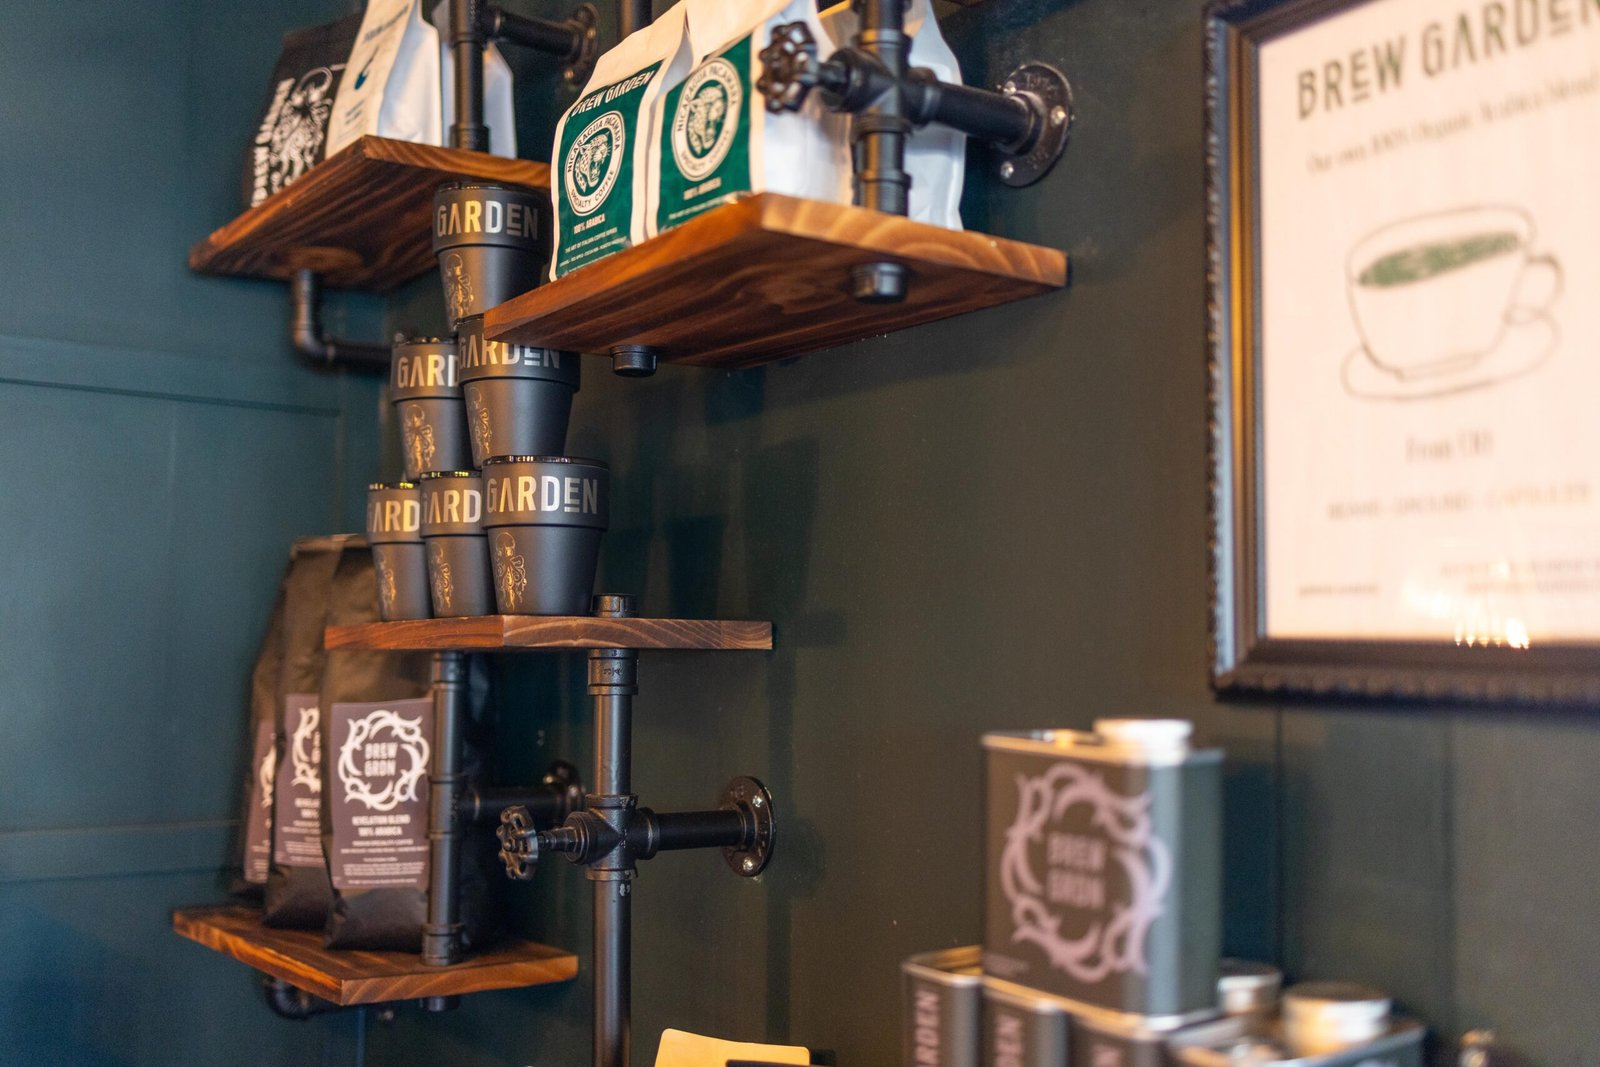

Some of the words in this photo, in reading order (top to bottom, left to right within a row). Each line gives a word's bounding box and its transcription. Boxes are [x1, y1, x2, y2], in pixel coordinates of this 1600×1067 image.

[605, 70, 655, 104] GARDEN
[1298, 33, 1407, 120] BREW
[567, 120, 603, 173] NICARAGUA
[594, 170, 614, 201] COFFEE
[437, 200, 538, 240] GARDEN
[486, 475, 598, 515] GARDEN
[364, 742, 398, 760] BREW
[915, 988, 940, 1067] RDEN
